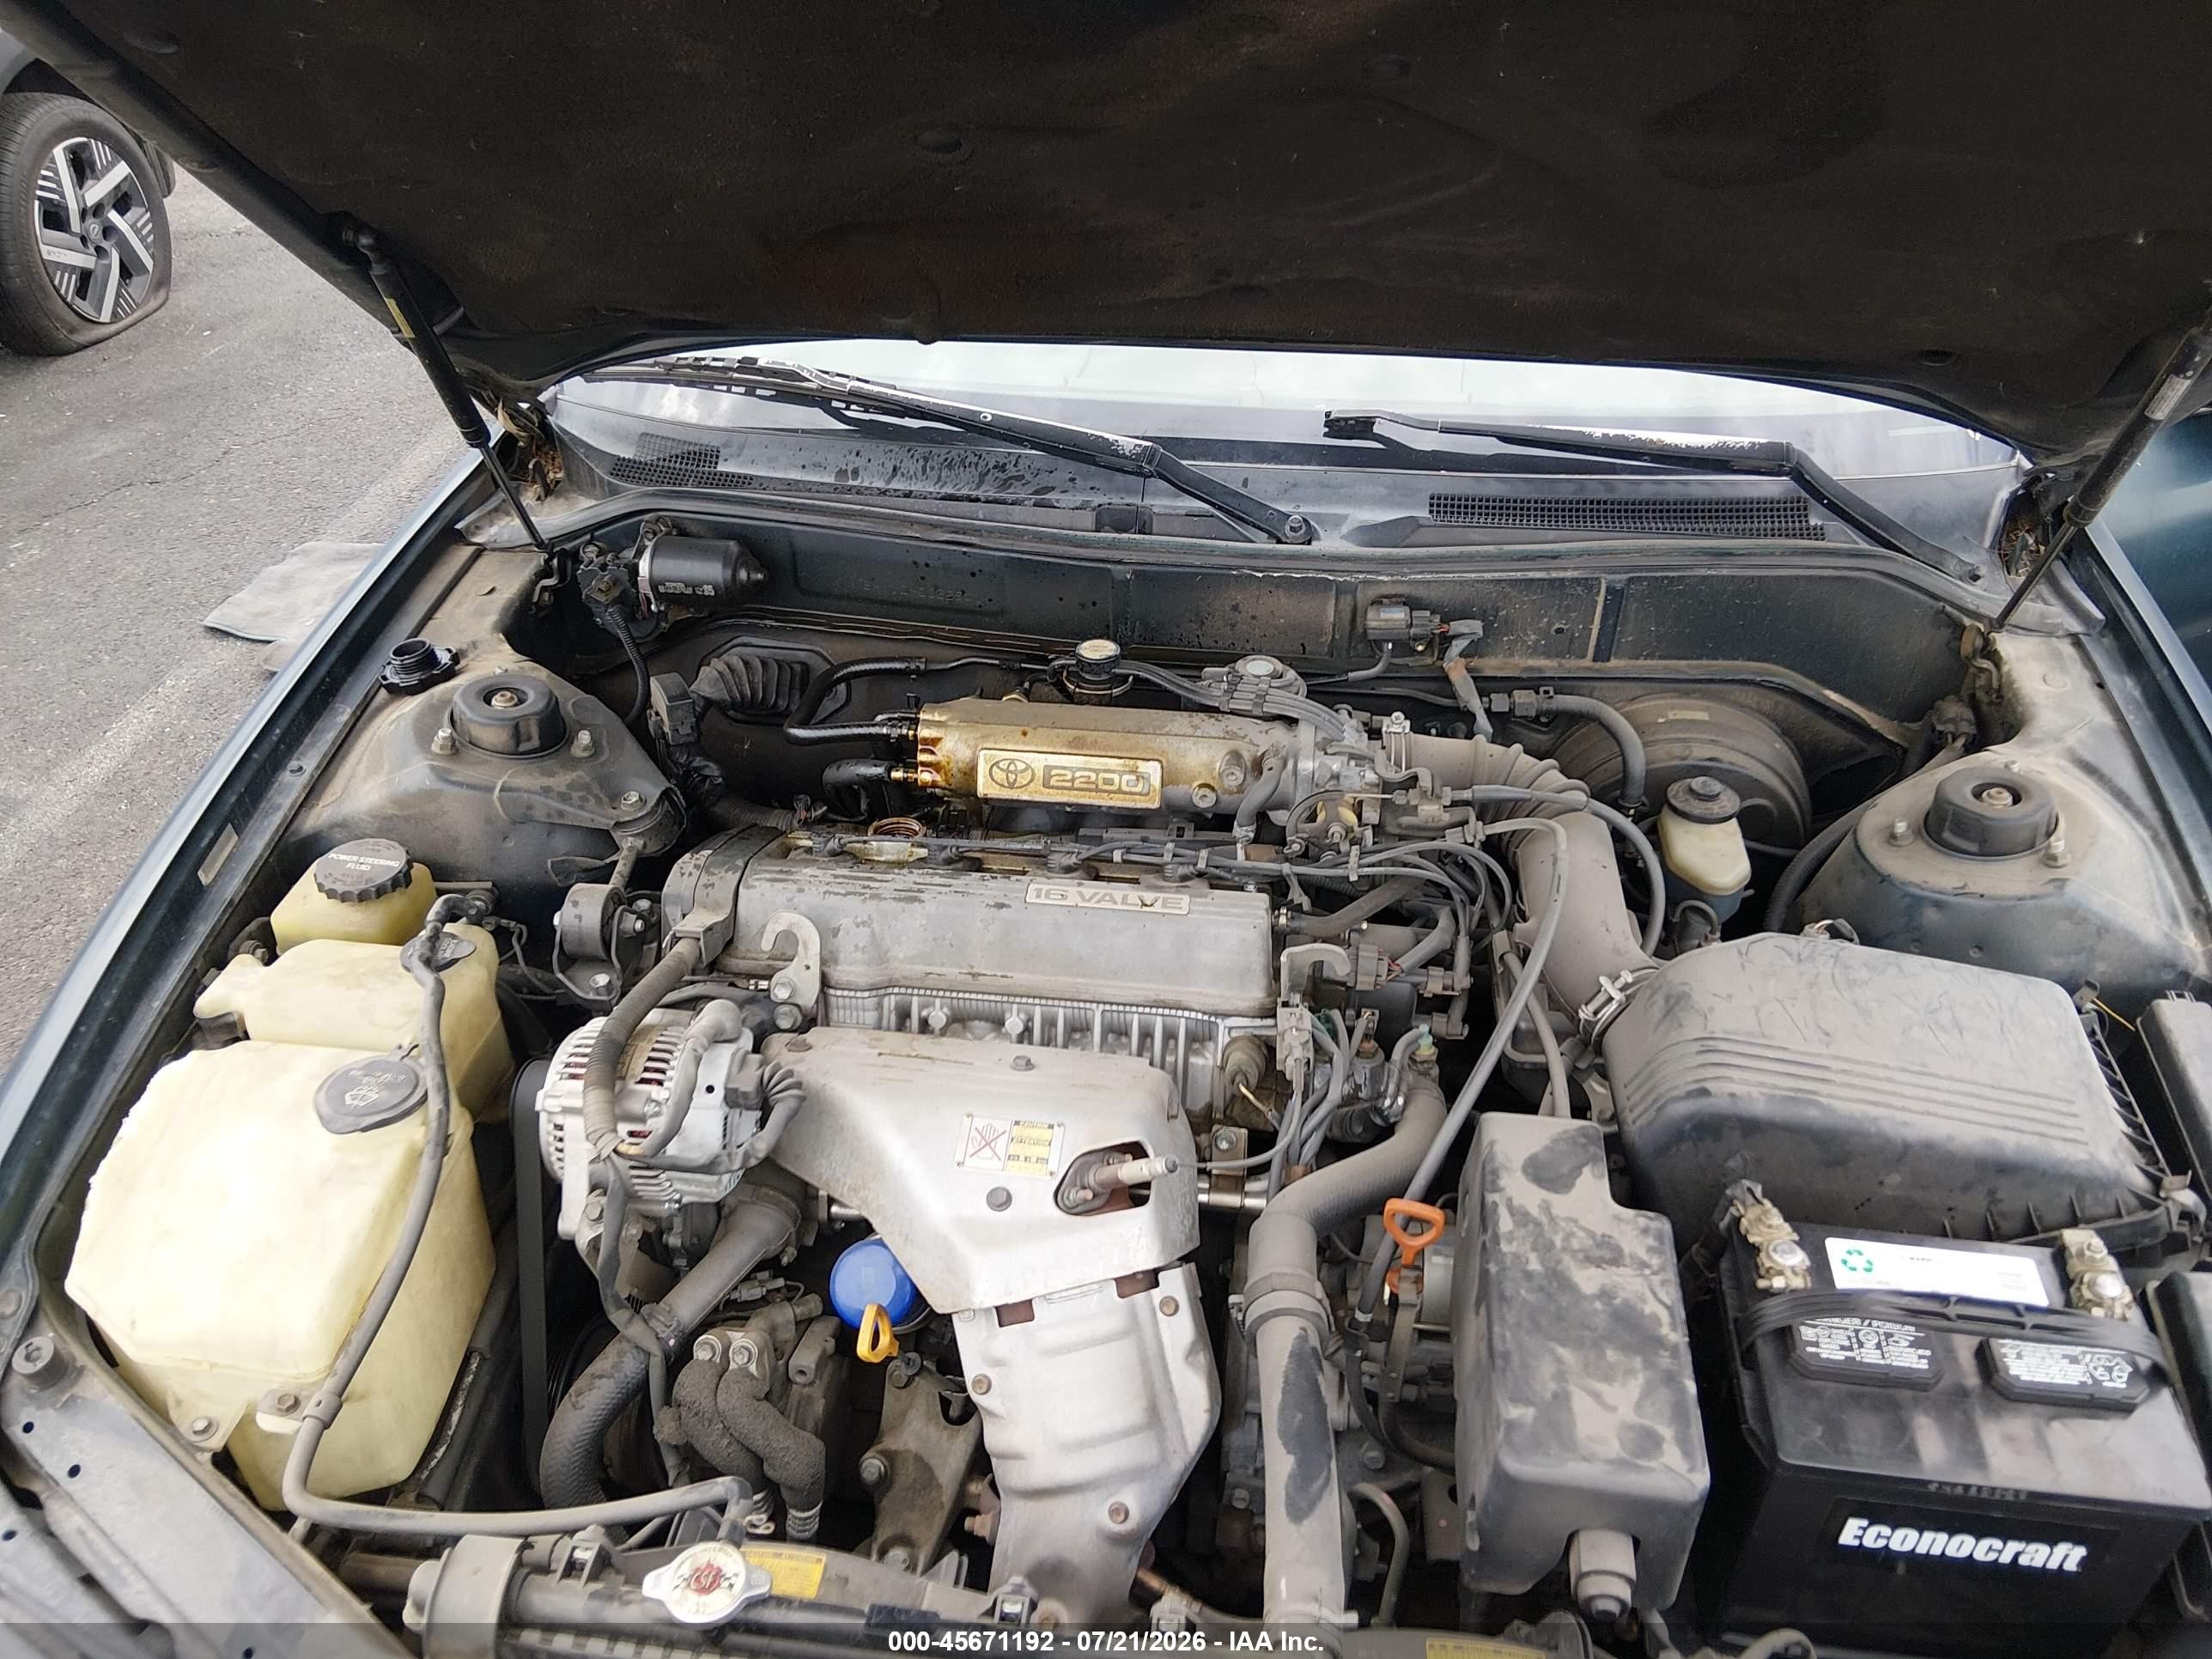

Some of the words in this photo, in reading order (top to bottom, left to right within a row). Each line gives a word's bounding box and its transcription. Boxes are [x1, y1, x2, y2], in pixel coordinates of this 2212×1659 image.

[1049, 769, 1144, 793] 2200
[328, 853, 358, 863] POWER
[358, 857, 400, 867] STEERING
[345, 862, 372, 871] FLUID
[1033, 887, 1069, 902] 16
[1076, 890, 1183, 910] VALVE
[1838, 1516, 2087, 1572] Econocraft
